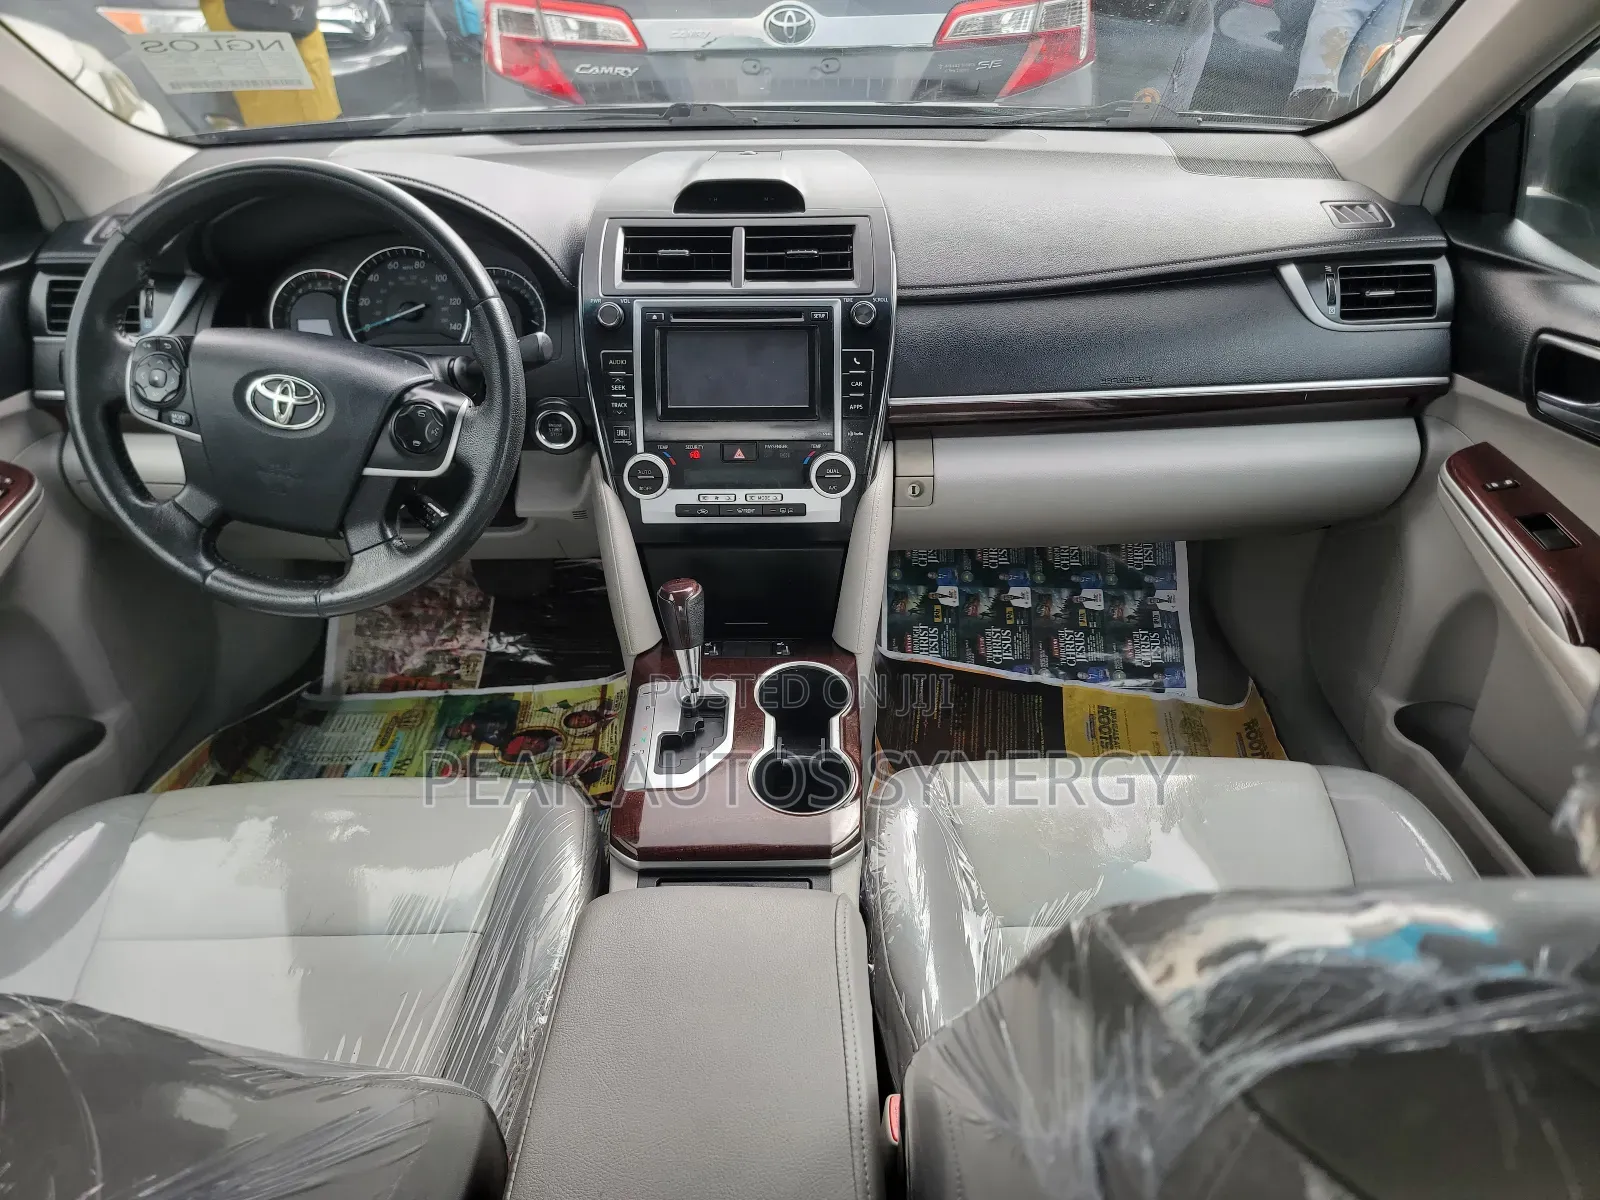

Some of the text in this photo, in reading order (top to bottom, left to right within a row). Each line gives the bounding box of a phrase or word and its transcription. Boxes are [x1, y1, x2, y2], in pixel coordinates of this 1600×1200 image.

[574, 63, 640, 78] CAMRY
[975, 59, 1003, 71] SE
[367, 273, 379, 282] 40
[387, 261, 399, 270] 60
[414, 260, 426, 269] 80
[435, 274, 448, 282] 100
[358, 297, 370, 306] 20
[449, 297, 462, 306] 120
[449, 323, 462, 331] 140
[1060, 545, 1070, 571] CHRI
[1143, 543, 1157, 567] JESU
[912, 625, 920, 653] HROUGH
[918, 623, 929, 656] HRIST
[928, 627, 941, 658] JESUS
[991, 626, 1003, 665] CHRIST
[1001, 629, 1015, 661] JESUS
[1058, 630, 1067, 665] THROUGH
[1064, 627, 1077, 667] CHRIST
[1074, 631, 1089, 663] JESUS
[1139, 628, 1152, 668] CHRIST
[1149, 632, 1165, 664] JESUS
[1097, 705, 1113, 750] ROOTS
[1243, 717, 1266, 759] ROOT
